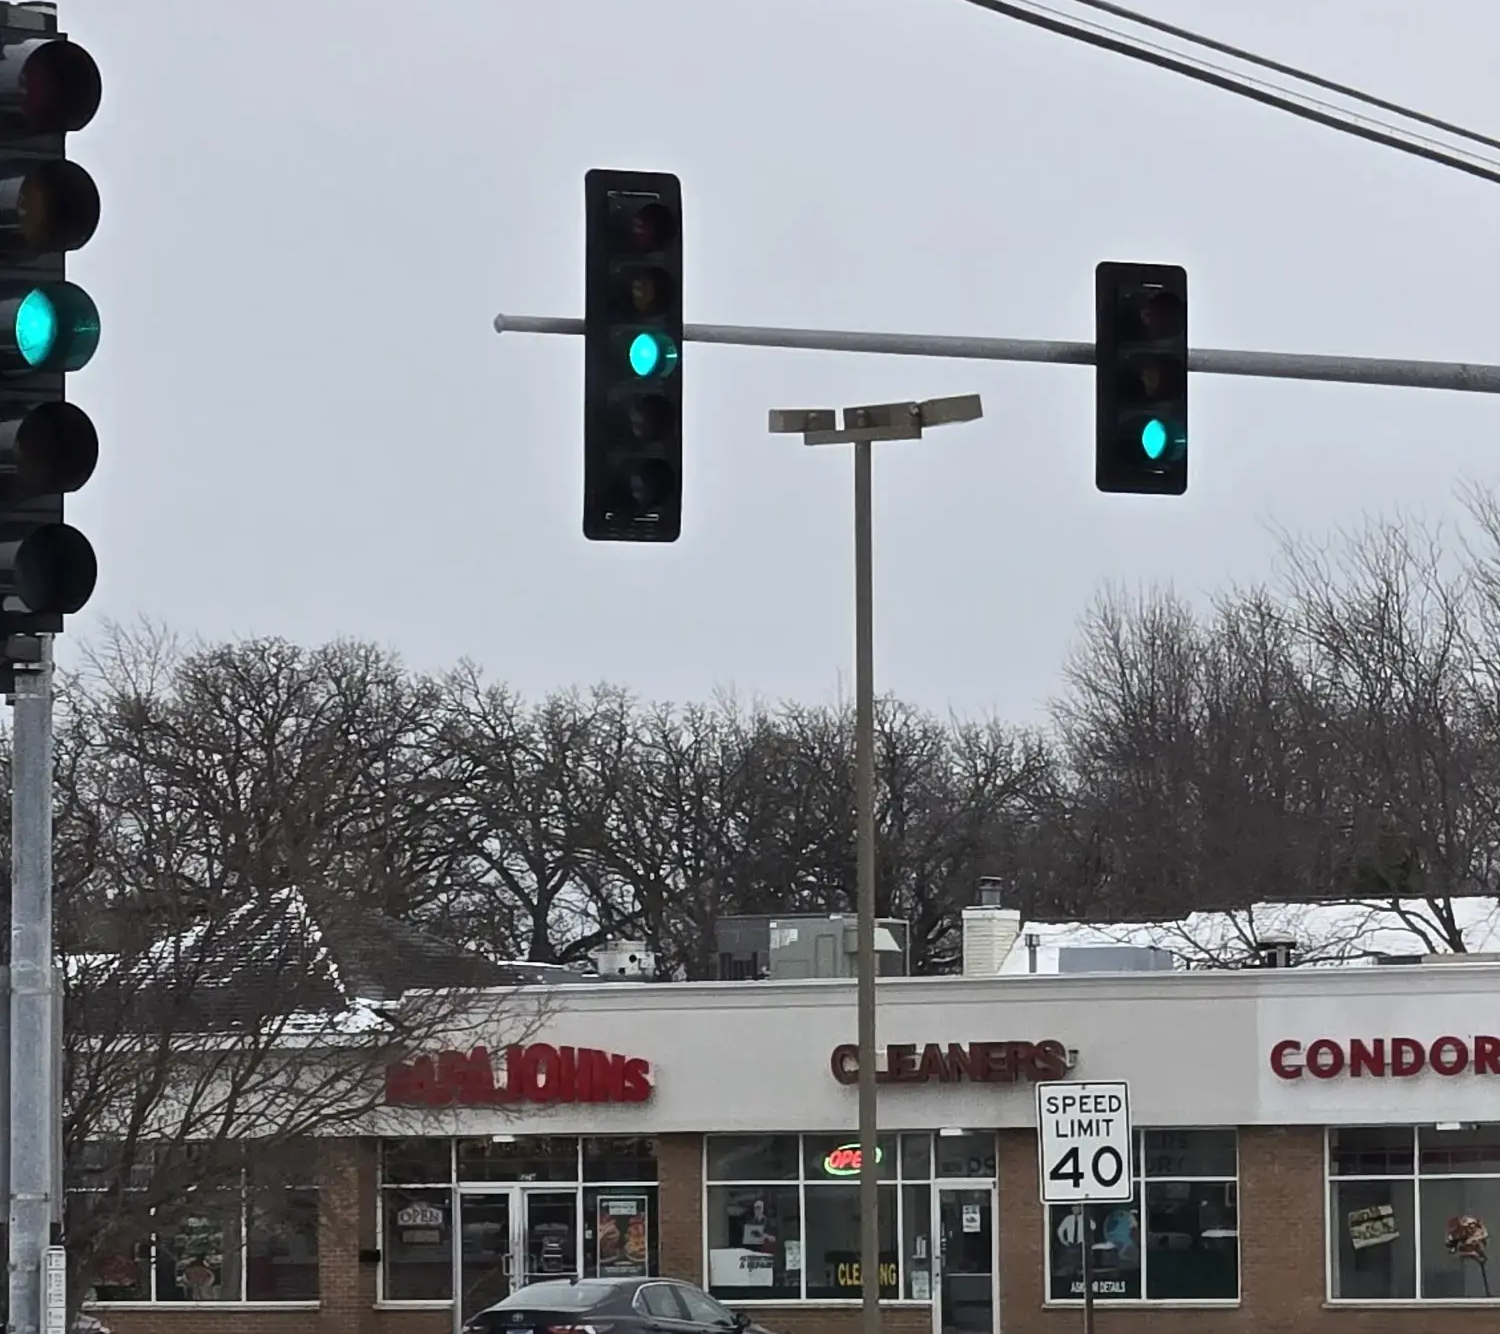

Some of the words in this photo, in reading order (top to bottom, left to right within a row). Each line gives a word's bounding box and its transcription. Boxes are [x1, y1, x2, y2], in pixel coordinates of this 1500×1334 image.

[493, 1042, 650, 1105] JOHNS
[1046, 1094, 1122, 1115] SPEED
[1055, 1118, 1114, 1138] LIMIT
[829, 1149, 863, 1169] OPE
[1049, 1145, 1123, 1188] 40
